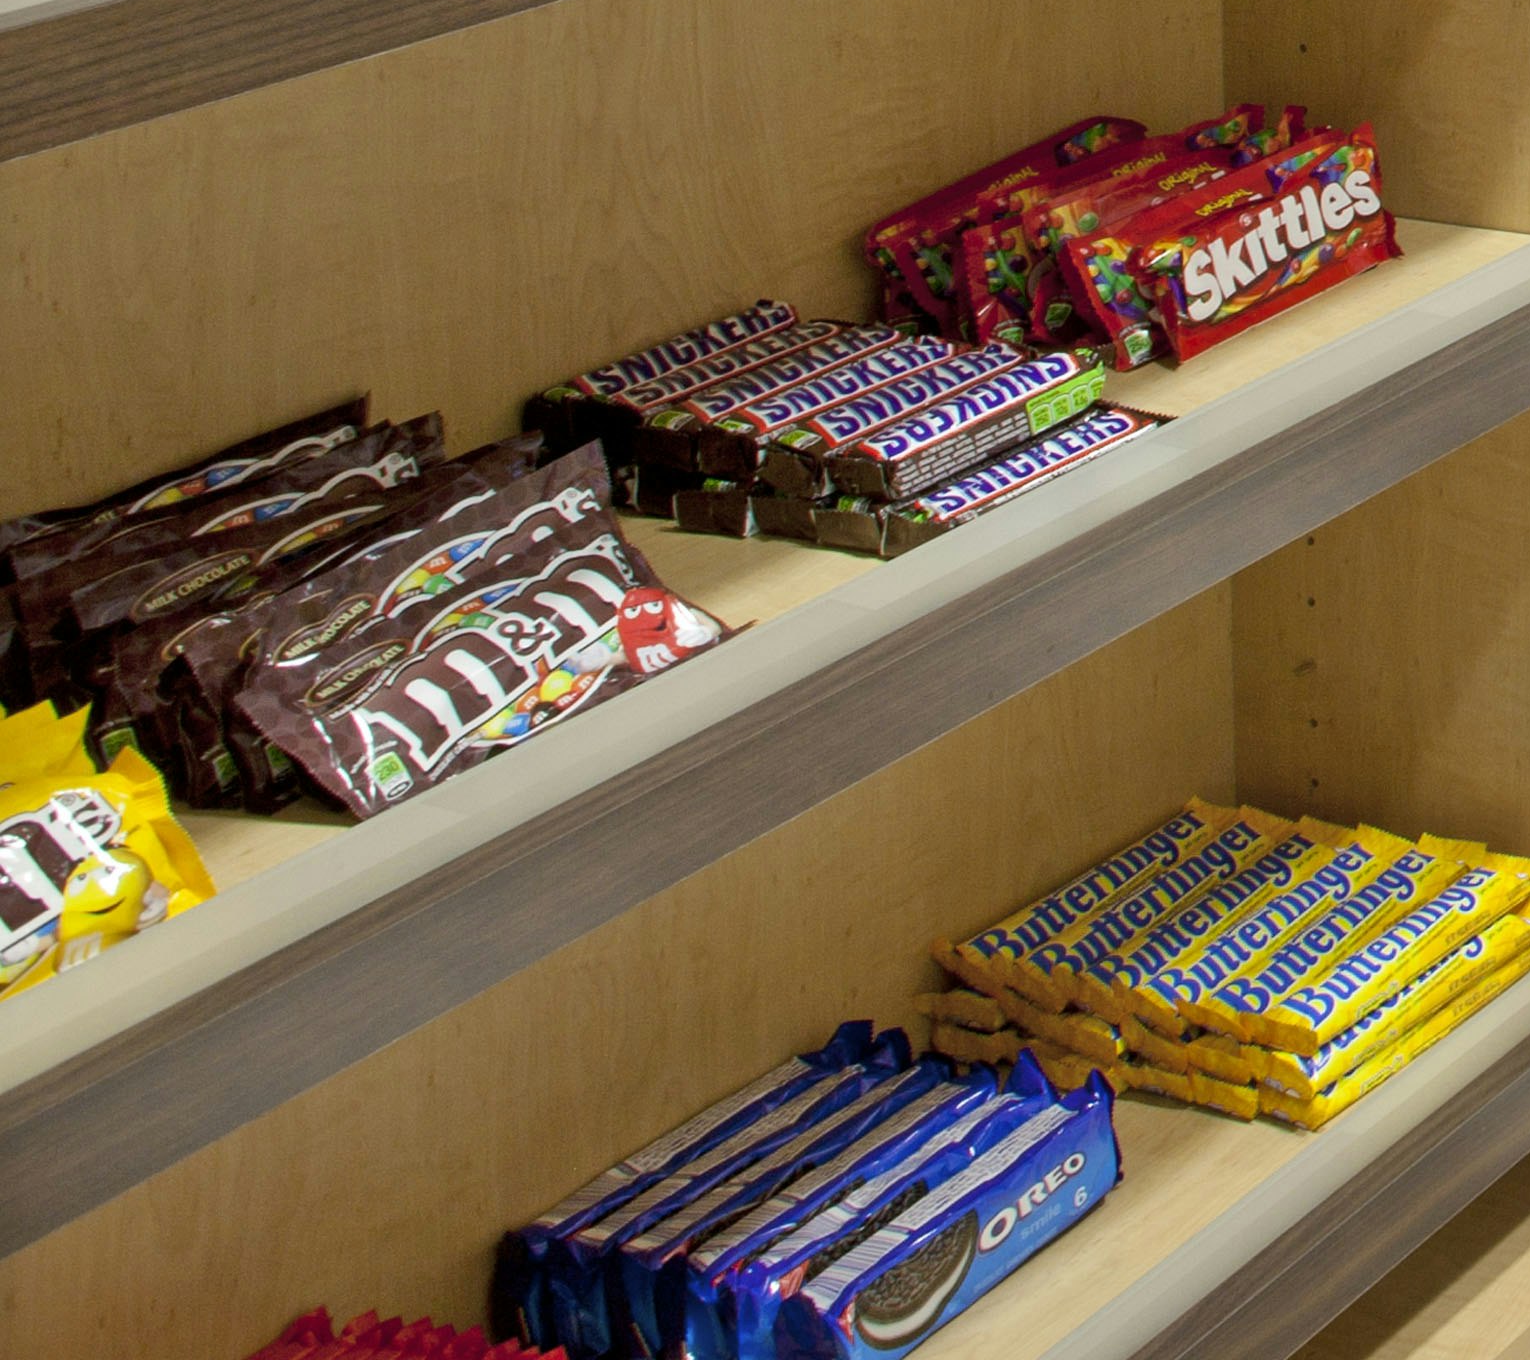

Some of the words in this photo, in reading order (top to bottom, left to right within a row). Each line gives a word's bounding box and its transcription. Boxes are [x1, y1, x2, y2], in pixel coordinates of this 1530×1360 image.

[1183, 170, 1382, 322] Skittles
[756, 337, 951, 425] SNICKERS
[822, 343, 1018, 436] SNICKERS
[876, 354, 1078, 458] SNICKERS
[927, 410, 1133, 515] SNICKERS
[180, 554, 252, 597] CHOCOLATE
[1282, 863, 1498, 1032] Butterfinger
[976, 1149, 1087, 1253] OREO
[1072, 1184, 1089, 1209] 6
